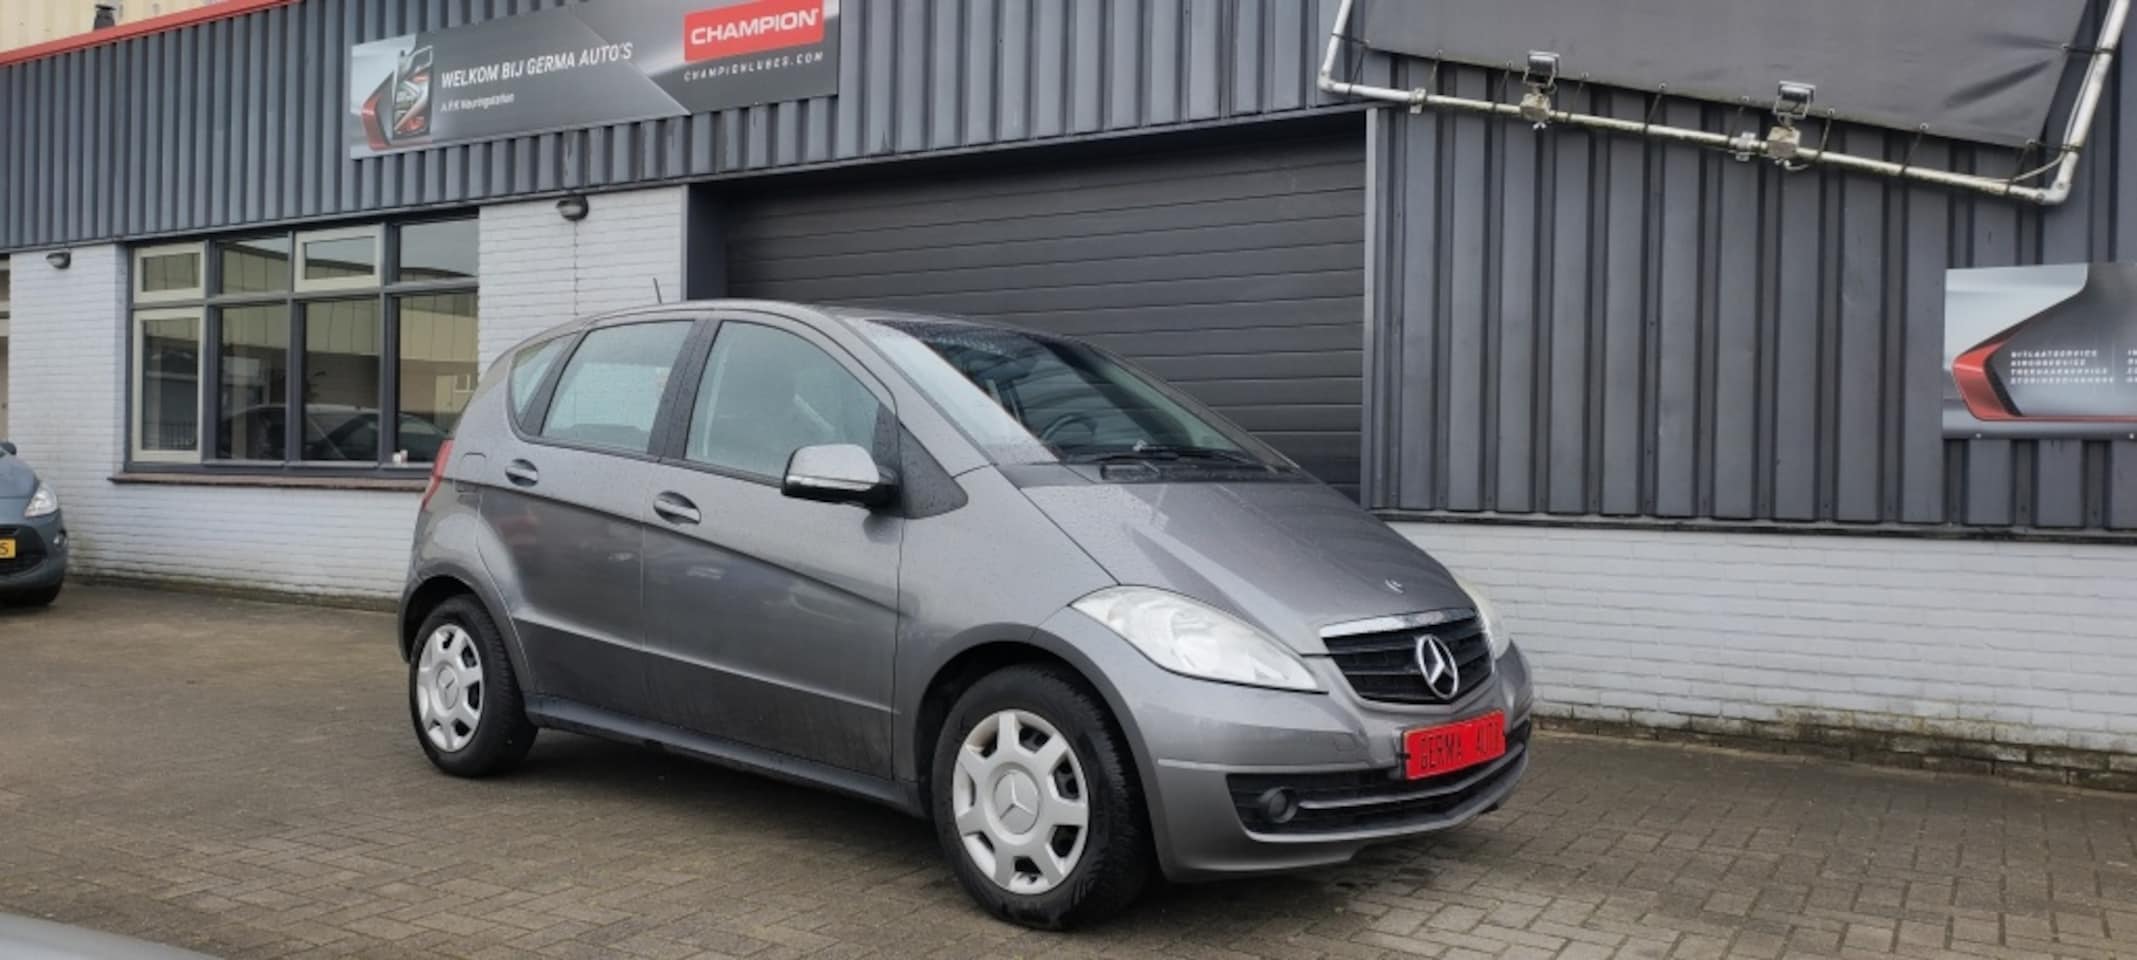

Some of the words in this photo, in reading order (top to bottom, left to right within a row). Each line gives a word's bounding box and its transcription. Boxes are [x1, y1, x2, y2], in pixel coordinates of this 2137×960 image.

[690, 9, 818, 45] CHAMPION
[441, 64, 500, 88] WELKOM
[502, 60, 525, 80] BIJ
[527, 51, 576, 75] GERMA
[579, 42, 634, 66] AUTO'S
[683, 51, 824, 82] CHAMPIONLUBES.COM
[1420, 733, 1462, 769] GERMA
